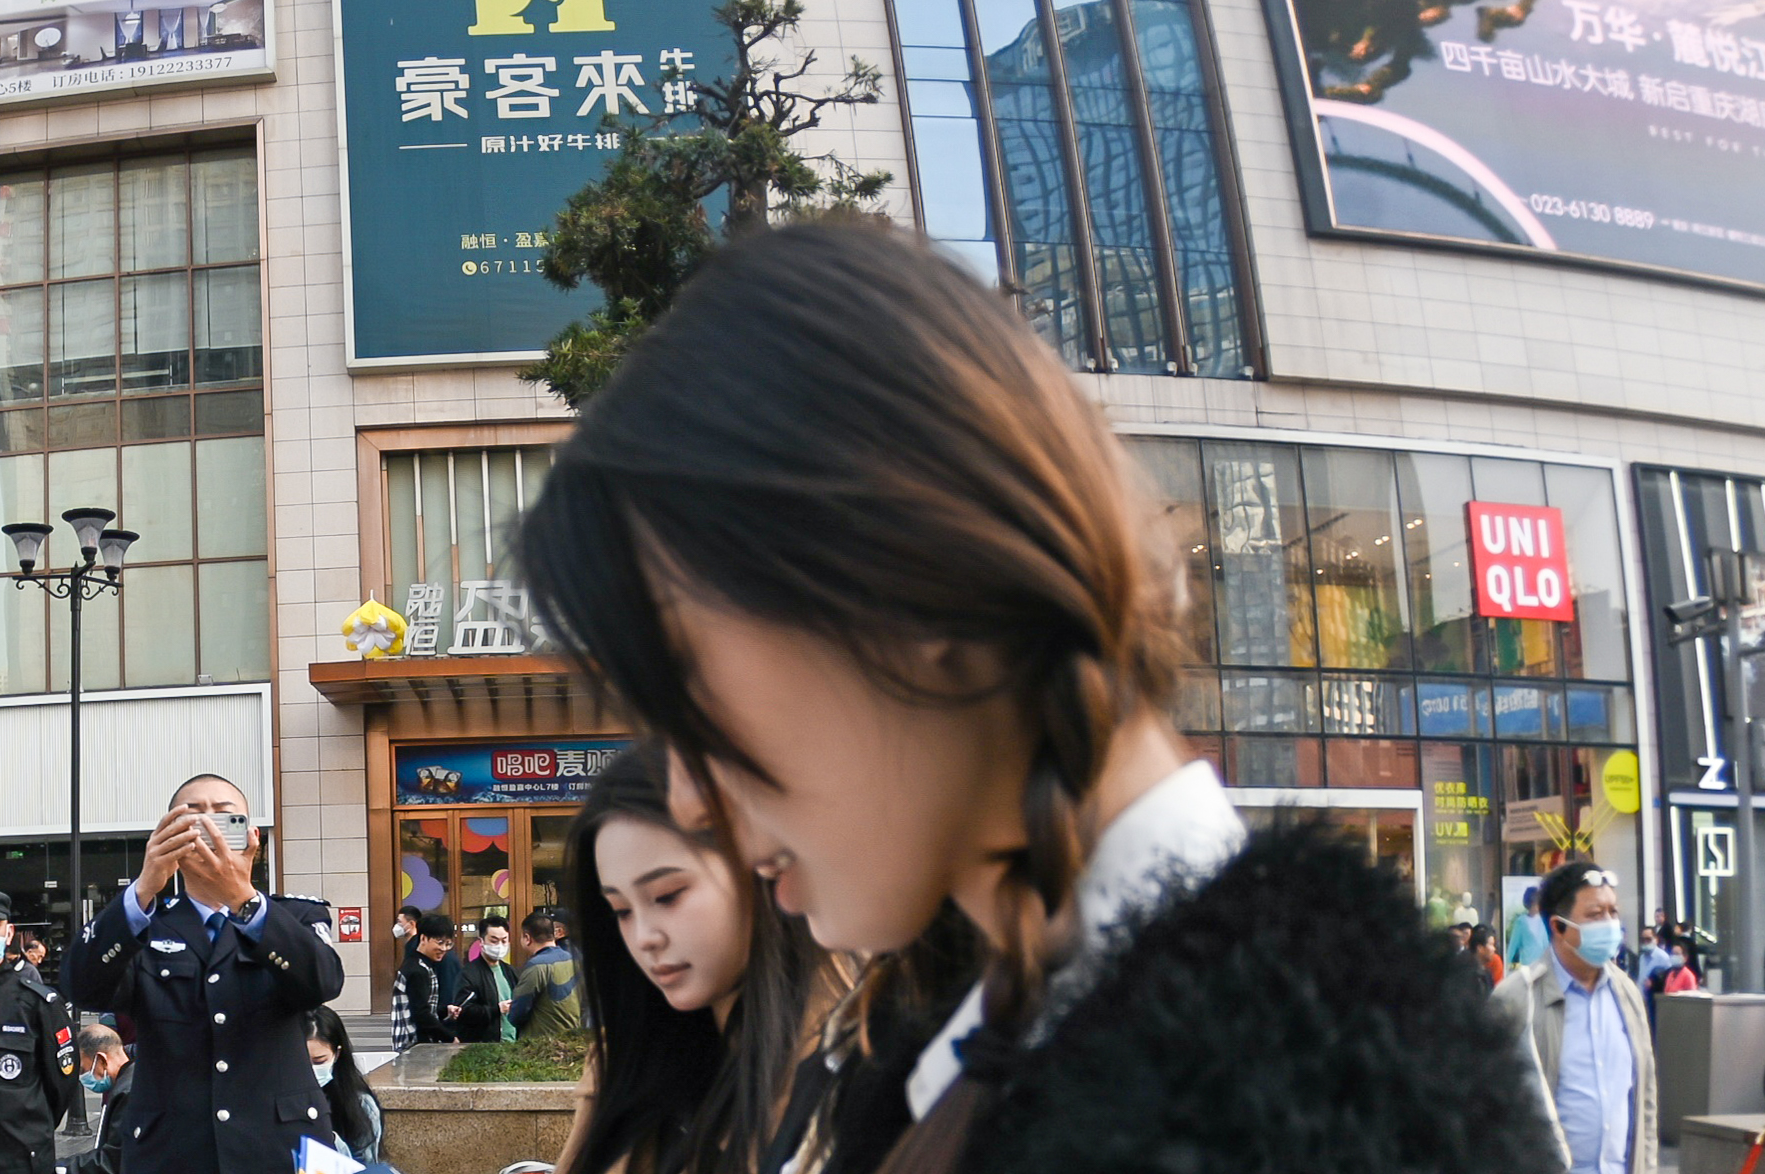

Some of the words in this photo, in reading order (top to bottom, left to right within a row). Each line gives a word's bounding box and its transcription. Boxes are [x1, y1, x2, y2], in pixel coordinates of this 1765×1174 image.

[480, 133, 622, 153] 原汁好牛排
[1479, 514, 1552, 558] UNI
[1485, 564, 1562, 612] QLO
